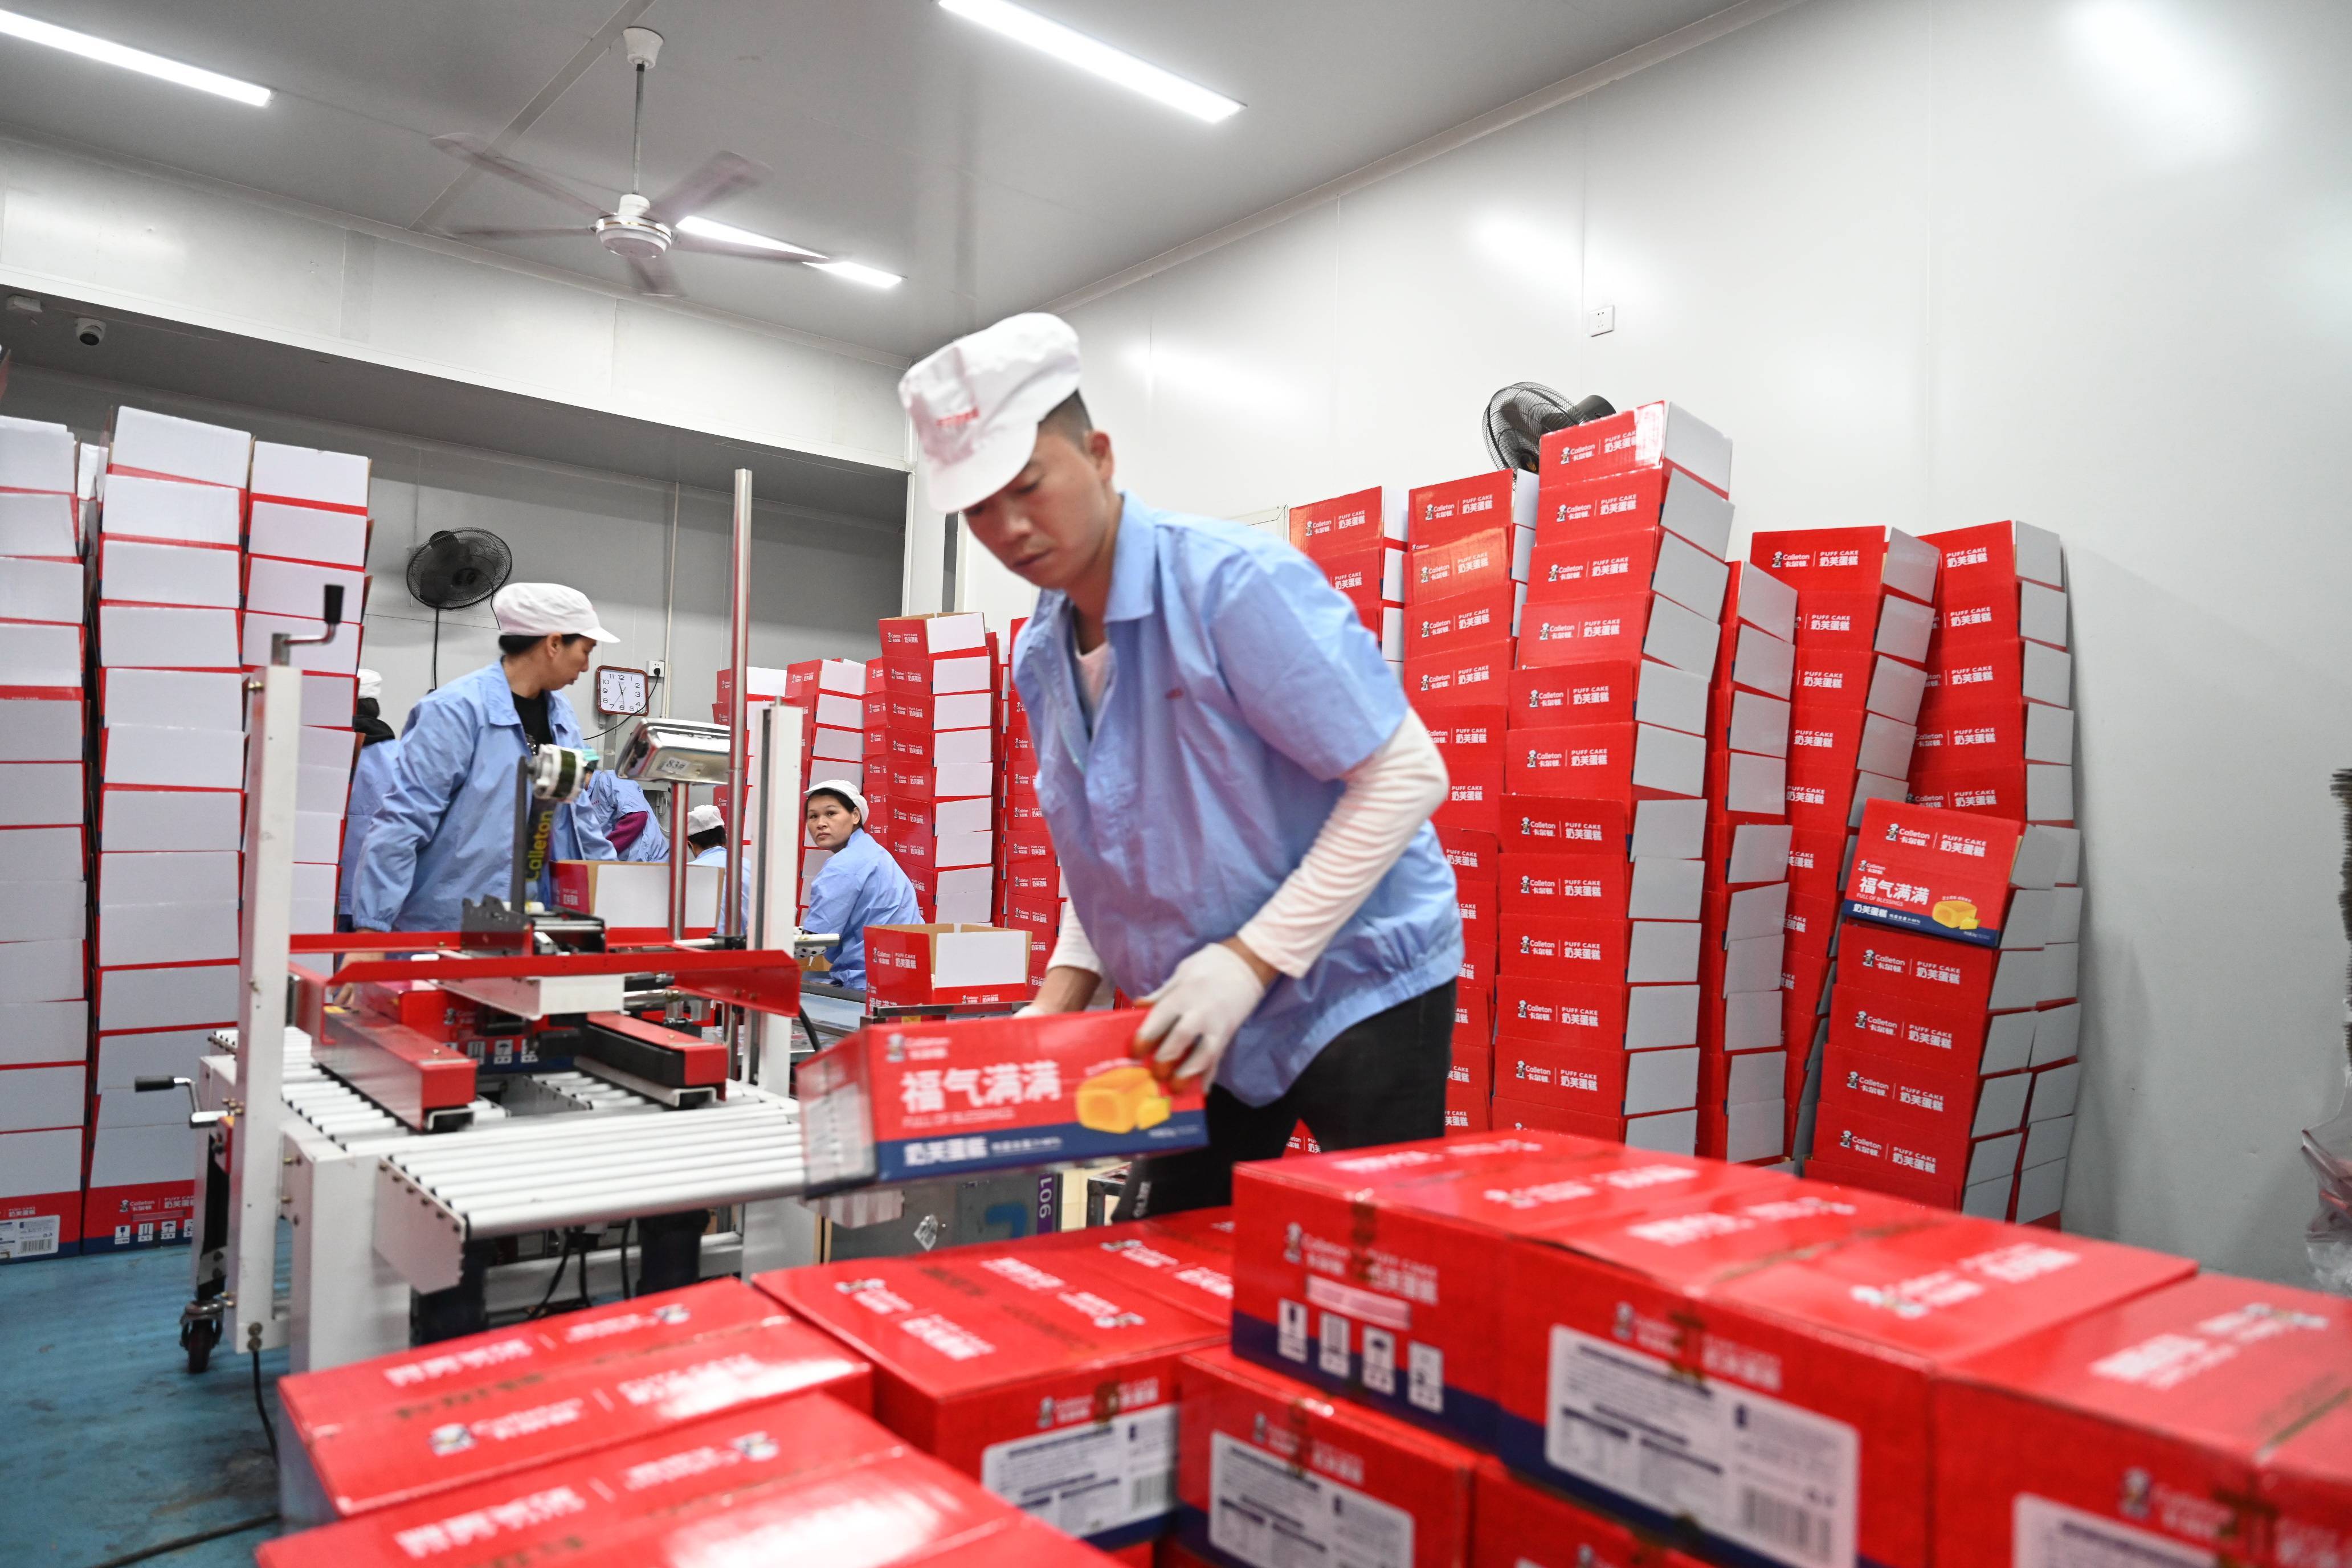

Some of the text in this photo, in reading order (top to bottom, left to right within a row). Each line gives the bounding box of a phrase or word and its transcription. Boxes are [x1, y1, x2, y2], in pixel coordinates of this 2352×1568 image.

[1623, 430, 1636, 438] CAK
[1819, 556, 1858, 566] 奶芙蛋糕
[1430, 620, 1451, 629] Calleton
[1954, 733, 1995, 745] 奶芙蛋糕
[1571, 754, 1607, 766] 奶芙蛋糕
[1566, 828, 1602, 840] 奶芙蛋糕
[1899, 828, 1930, 839] Calleton
[1940, 840, 1985, 857] 奶芙蛋糕
[1565, 885, 1601, 897] 奶芙蛋糕
[1859, 876, 1930, 905] 福气满满
[1876, 896, 1904, 906] BLESSINGS
[1852, 903, 1888, 918] 奶芙蛋糕
[1565, 948, 1600, 959] 奶芙蛋糕
[1875, 954, 1905, 965] Calleton
[1916, 967, 1960, 984] 奶芙蛋糕
[1527, 1004, 1552, 1013] Calleton
[1562, 1012, 1598, 1026] 奶芙蛋糕
[1867, 1016, 1897, 1028] Calleton
[1908, 1030, 1951, 1049] 奶芙蛋糕
[1932, 1030, 1951, 1039] CAKE
[1525, 1065, 1551, 1075] Calleton
[901, 1059, 1061, 1113] 福气满满
[1561, 1076, 1597, 1091] 奶芙蛋糕
[1859, 1077, 1889, 1089] Calleton
[1901, 1086, 1943, 1101] PUFF CAKE
[1900, 1092, 1943, 1112] 奶芙蛋糕
[1852, 1136, 1881, 1149] Calleton
[1893, 1147, 1936, 1162] PUFF CAKE
[1893, 1153, 1936, 1173] 奶芙蛋糕
